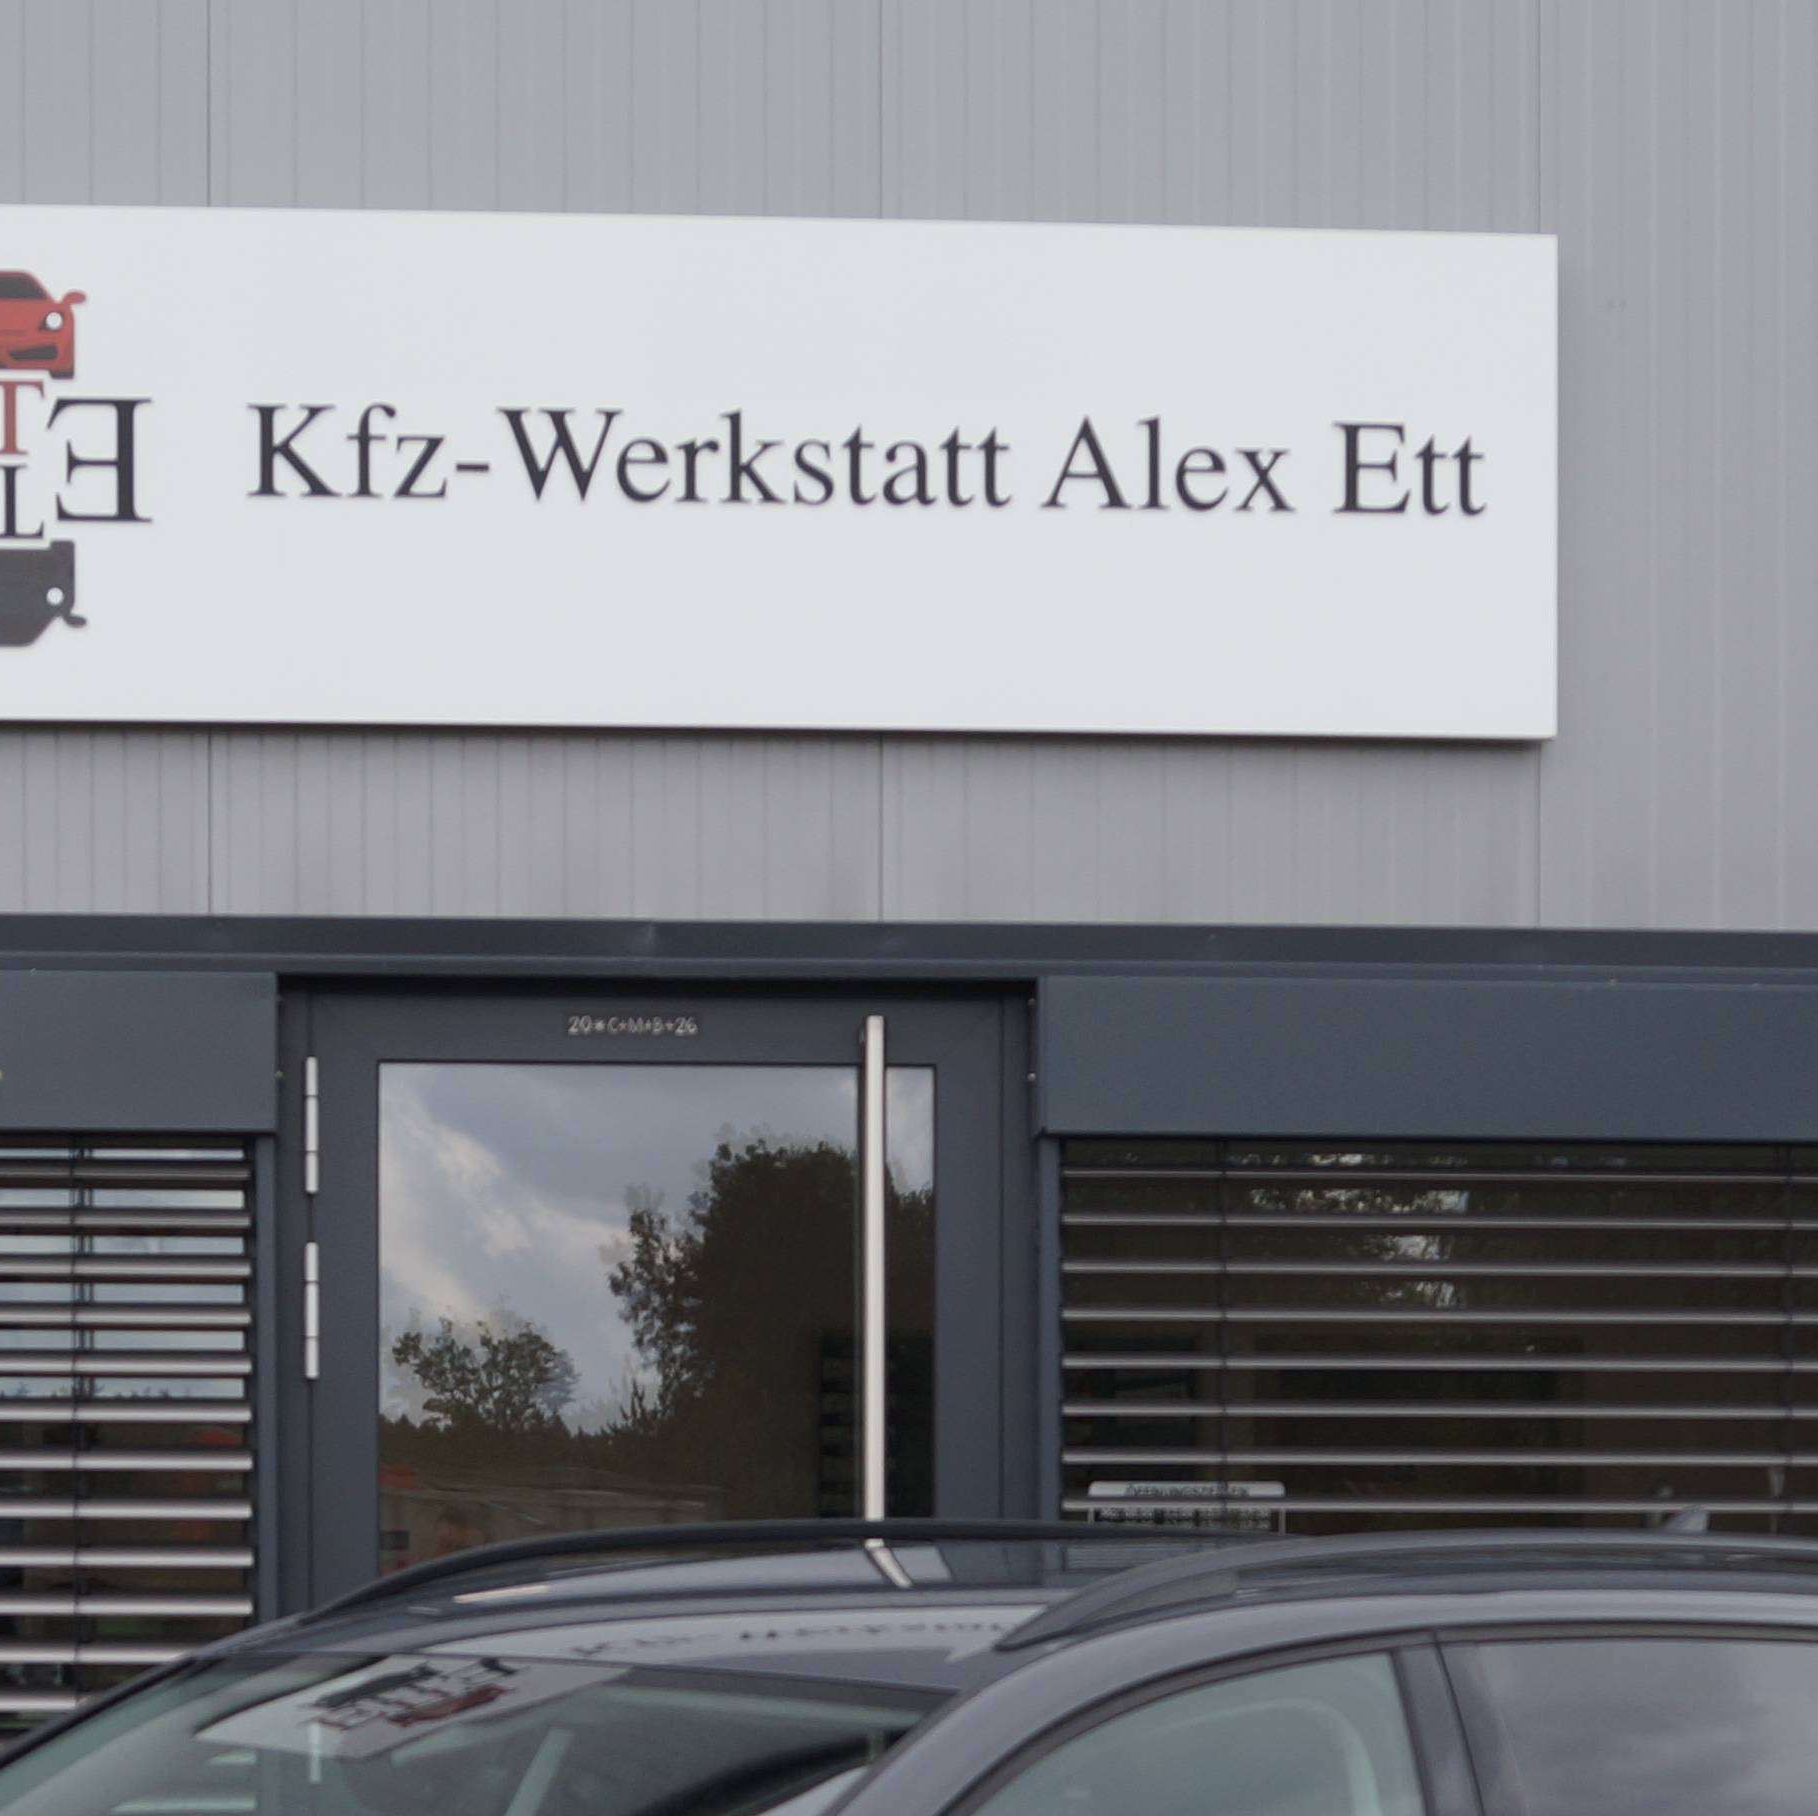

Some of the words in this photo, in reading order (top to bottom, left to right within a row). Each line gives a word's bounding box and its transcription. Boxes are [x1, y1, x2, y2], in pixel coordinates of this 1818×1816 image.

[246, 402, 1013, 507] Kfz-Werkstatt
[1039, 414, 1297, 514] Alex
[1331, 420, 1488, 516] Ett
